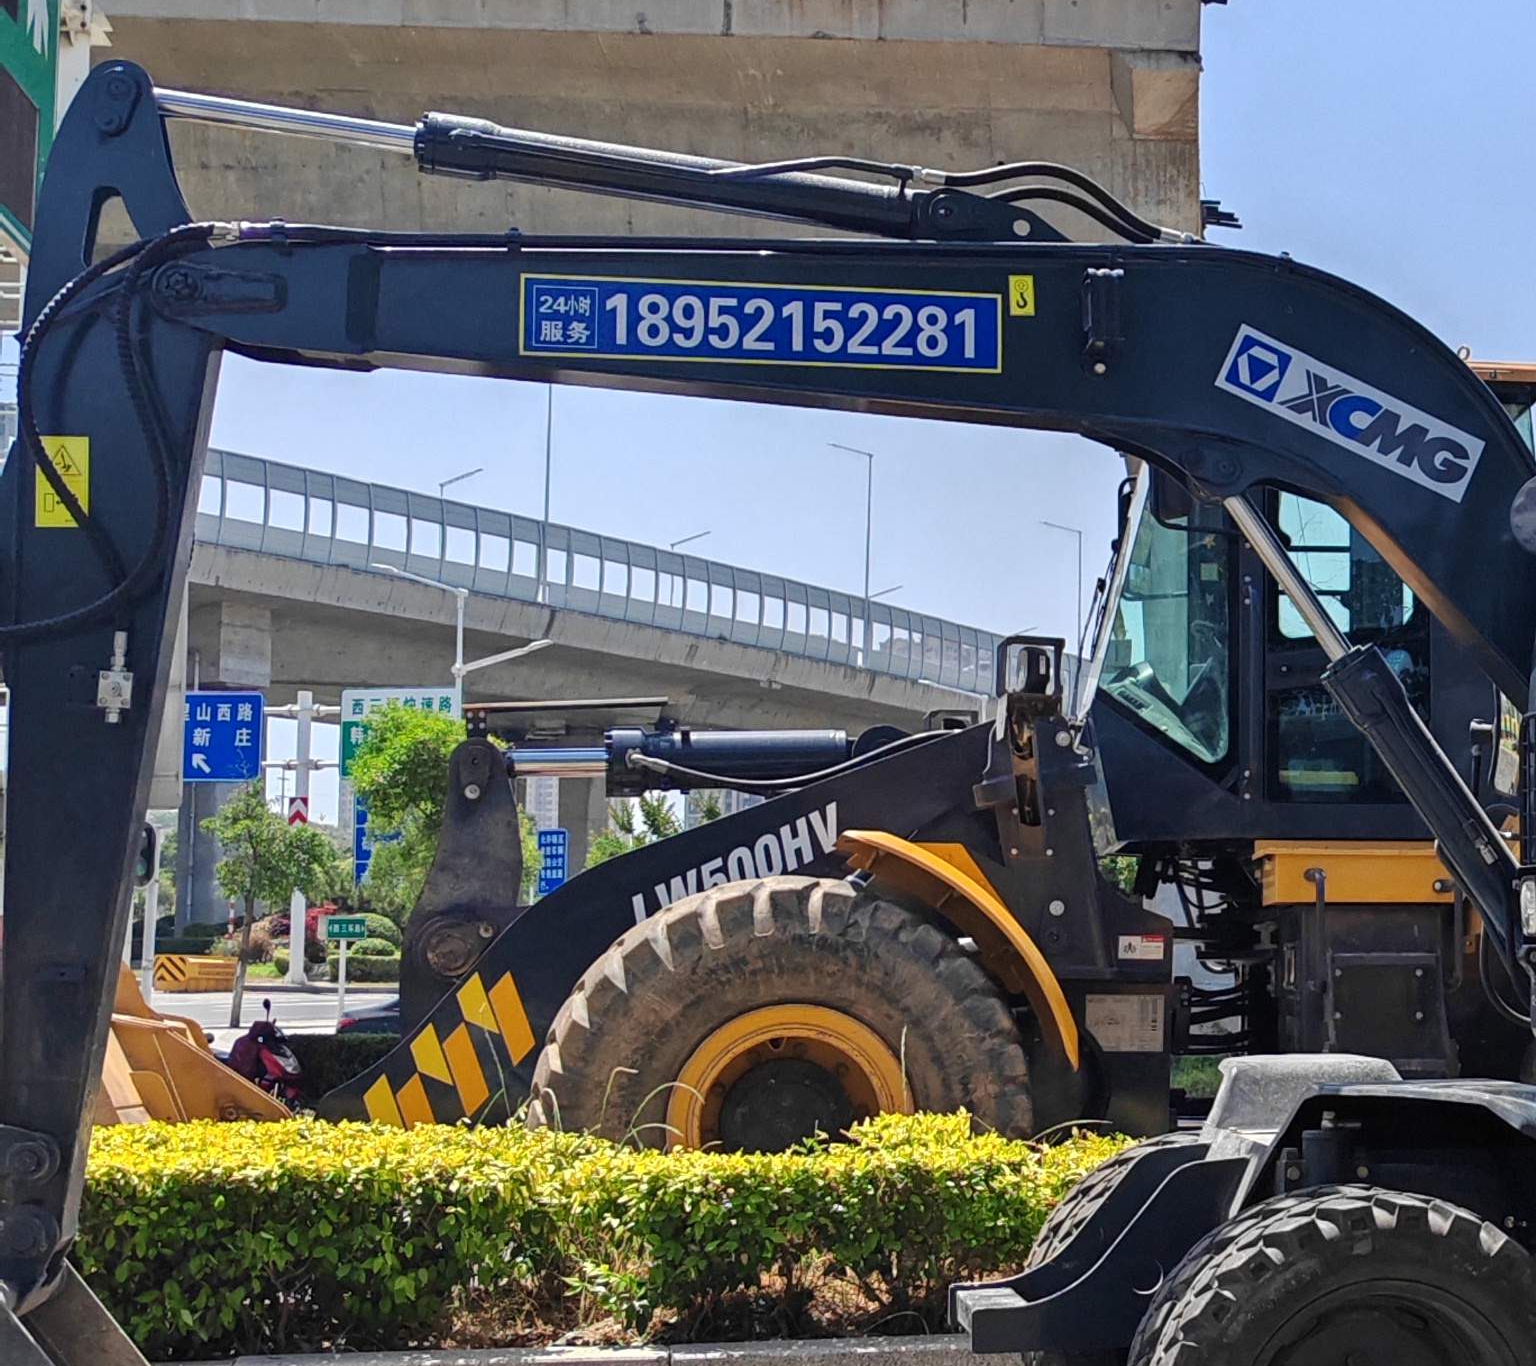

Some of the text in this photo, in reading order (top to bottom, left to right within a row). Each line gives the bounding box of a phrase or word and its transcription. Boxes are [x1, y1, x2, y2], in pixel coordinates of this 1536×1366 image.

[538, 293, 592, 318] 24小时
[539, 319, 591, 344] 服务
[604, 292, 976, 360] 18952152281
[1276, 368, 1472, 485] XCMG
[192, 727, 252, 747] 新庄
